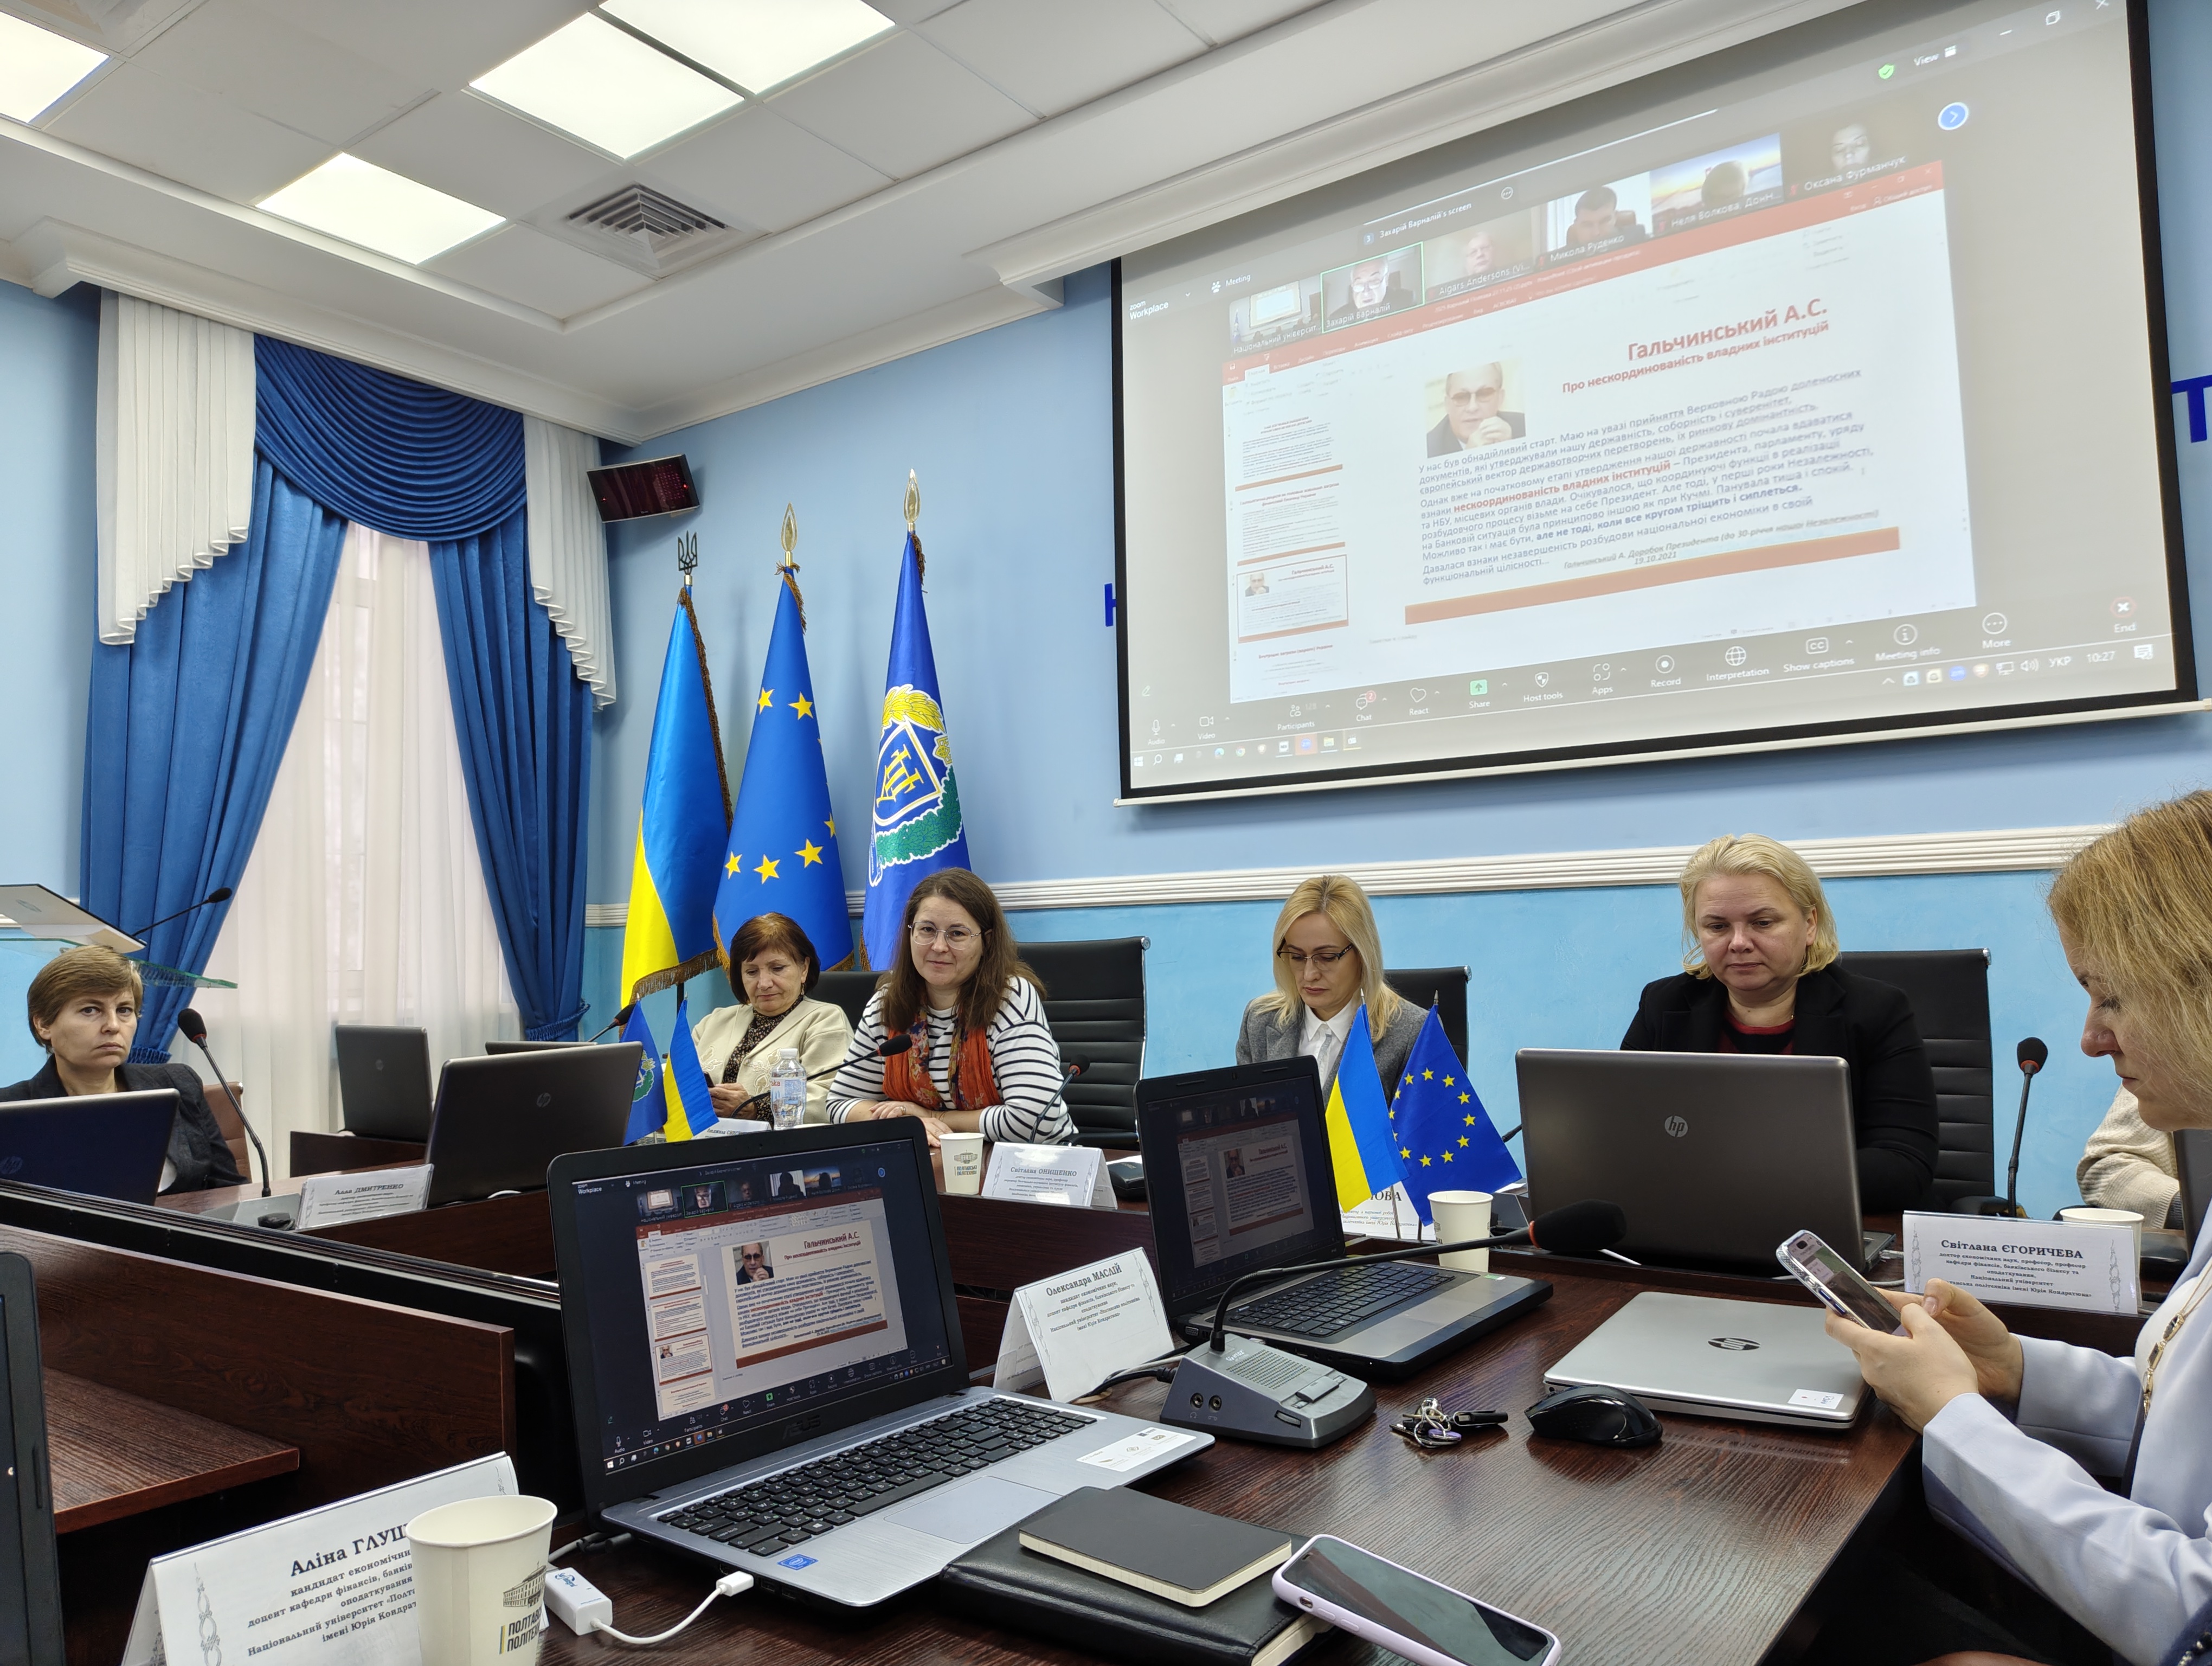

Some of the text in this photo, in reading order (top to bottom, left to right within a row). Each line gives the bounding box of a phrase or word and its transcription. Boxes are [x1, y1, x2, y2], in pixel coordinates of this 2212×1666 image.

[1913, 50, 1939, 67] View
[1804, 154, 1906, 191] Оксана Фурманчук
[1379, 222, 1407, 239] Захарій
[1408, 209, 1446, 229] Варналій's
[1448, 202, 1471, 215] screen
[1671, 214, 1695, 229] Неля
[1550, 234, 1624, 263] Микола Руденко
[1226, 272, 1251, 289] Meeting
[1439, 280, 1464, 297] Aigars
[1467, 267, 1509, 287] Andersons
[1129, 300, 1146, 311] zoom
[1130, 300, 1168, 321] Workplace
[1326, 302, 1390, 328] Захарій Варналій
[1629, 297, 1827, 361] Гальчинський А.С.
[1233, 334, 1281, 355] Національний
[1562, 378, 1585, 395] Про
[1706, 340, 1760, 361] владних
[1763, 321, 1829, 348] інституцій
[1418, 465, 1425, 473] У
[1426, 463, 1442, 472] нас
[1443, 456, 1459, 470] був
[1461, 441, 1527, 466] обнадійливий
[1529, 437, 1557, 451] старт.
[1559, 429, 1584, 443] Маю
[1586, 428, 1599, 437] на
[1601, 420, 1627, 435] увазі
[1629, 407, 1684, 429] прийняття
[1687, 393, 1748, 416] Верховною
[1750, 382, 1789, 401] Радою
[1419, 464, 1472, 486] документів,
[1474, 462, 1487, 472] які
[1489, 448, 1558, 471] утверджували
[1560, 443, 1586, 456] нашу
[1587, 425, 1655, 450] державність,
[1657, 411, 1717, 435] соборність
[1419, 473, 1483, 496] європейський
[1485, 468, 1517, 482] вектор
[1519, 450, 1602, 476] державотворчих
[1688, 421, 1734, 439] ринкову
[1421, 507, 1452, 519] взнаки
[1454, 483, 1560, 514] нескоординованість
[1562, 475, 1610, 492] владних
[1612, 460, 1671, 483] інституцій
[1682, 443, 1752, 467] Президента,
[1423, 544, 1466, 561] Можливо
[1467, 544, 1482, 553] так
[1489, 540, 1508, 549] має
[1509, 533, 1534, 547] бути,
[1536, 531, 1554, 540] але
[1571, 521, 1594, 535] тоді,
[1597, 518, 1622, 529] коли
[1625, 514, 1642, 523] все
[1645, 506, 1683, 521] кругом
[1686, 495, 1731, 514] тріщить
[1739, 483, 1803, 502] сиплеться.
[1634, 551, 1677, 565] 19.10.2021
[1423, 565, 1494, 586] функціональній
[2113, 621, 2136, 633] End
[1982, 637, 2012, 649] More
[1875, 645, 1940, 663] Meeting info
[2049, 651, 2117, 668] УКР 10:27
[1783, 656, 1855, 672] Show captions
[1650, 677, 1681, 688] Record
[1706, 667, 1769, 682] Interpretation
[1523, 690, 1563, 703] Host tools
[1592, 685, 1613, 697] Apps
[1409, 707, 1428, 716] React
[1469, 699, 1490, 709] Share
[1277, 720, 1315, 732] Participants
[1356, 713, 1372, 722] Chat
[1148, 738, 1165, 746] Audio
[1198, 732, 1215, 740] Video
[1038, 1168, 1077, 1177] ОНИЩЕНКО
[354, 1183, 404, 1194] ДМИТРЕНКО
[578, 1186, 602, 1195] Workplace
[803, 1231, 859, 1249] Гальчинський А.С.
[1941, 1239, 2083, 1259] Світлана ЄГОРИЧЕВА
[2021, 1259, 2053, 1267] професор,
[2055, 1261, 2086, 1270] професор
[1046, 1263, 1122, 1296] Олександра МАСЛІЙ
[2015, 1278, 2054, 1287] університет
[782, 1415, 821, 1440] ASUS
[291, 1548, 348, 1577] Аліна
[291, 1549, 411, 1597] кандидат економічни
[248, 1563, 413, 1628] доцент кафедри фінансів, банків
[340, 1576, 413, 1607] оподаткування
[248, 1622, 323, 1656] Національний
[325, 1600, 383, 1628] університет
[323, 1601, 416, 1642] імені Юрія Кондрат
